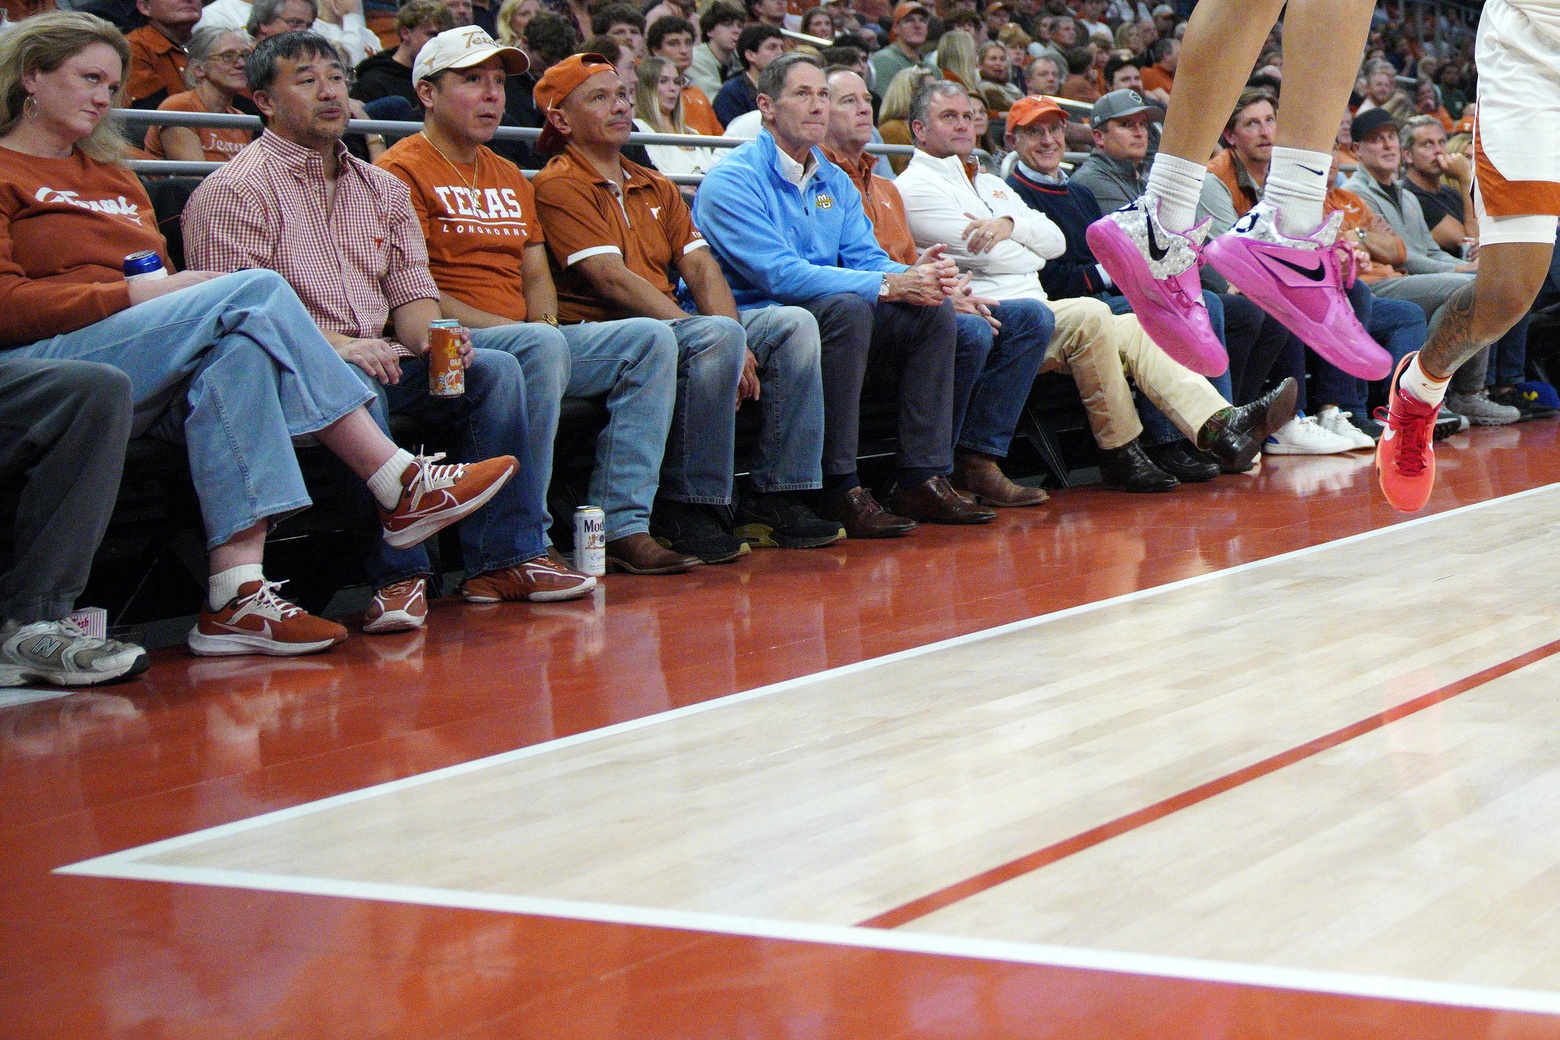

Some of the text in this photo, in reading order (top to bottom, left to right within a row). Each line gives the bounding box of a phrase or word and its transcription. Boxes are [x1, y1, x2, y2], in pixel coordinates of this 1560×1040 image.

[434, 185, 522, 219] TEXAS
[442, 224, 528, 236] LONGHORNS
[31, 636, 63, 658] N
